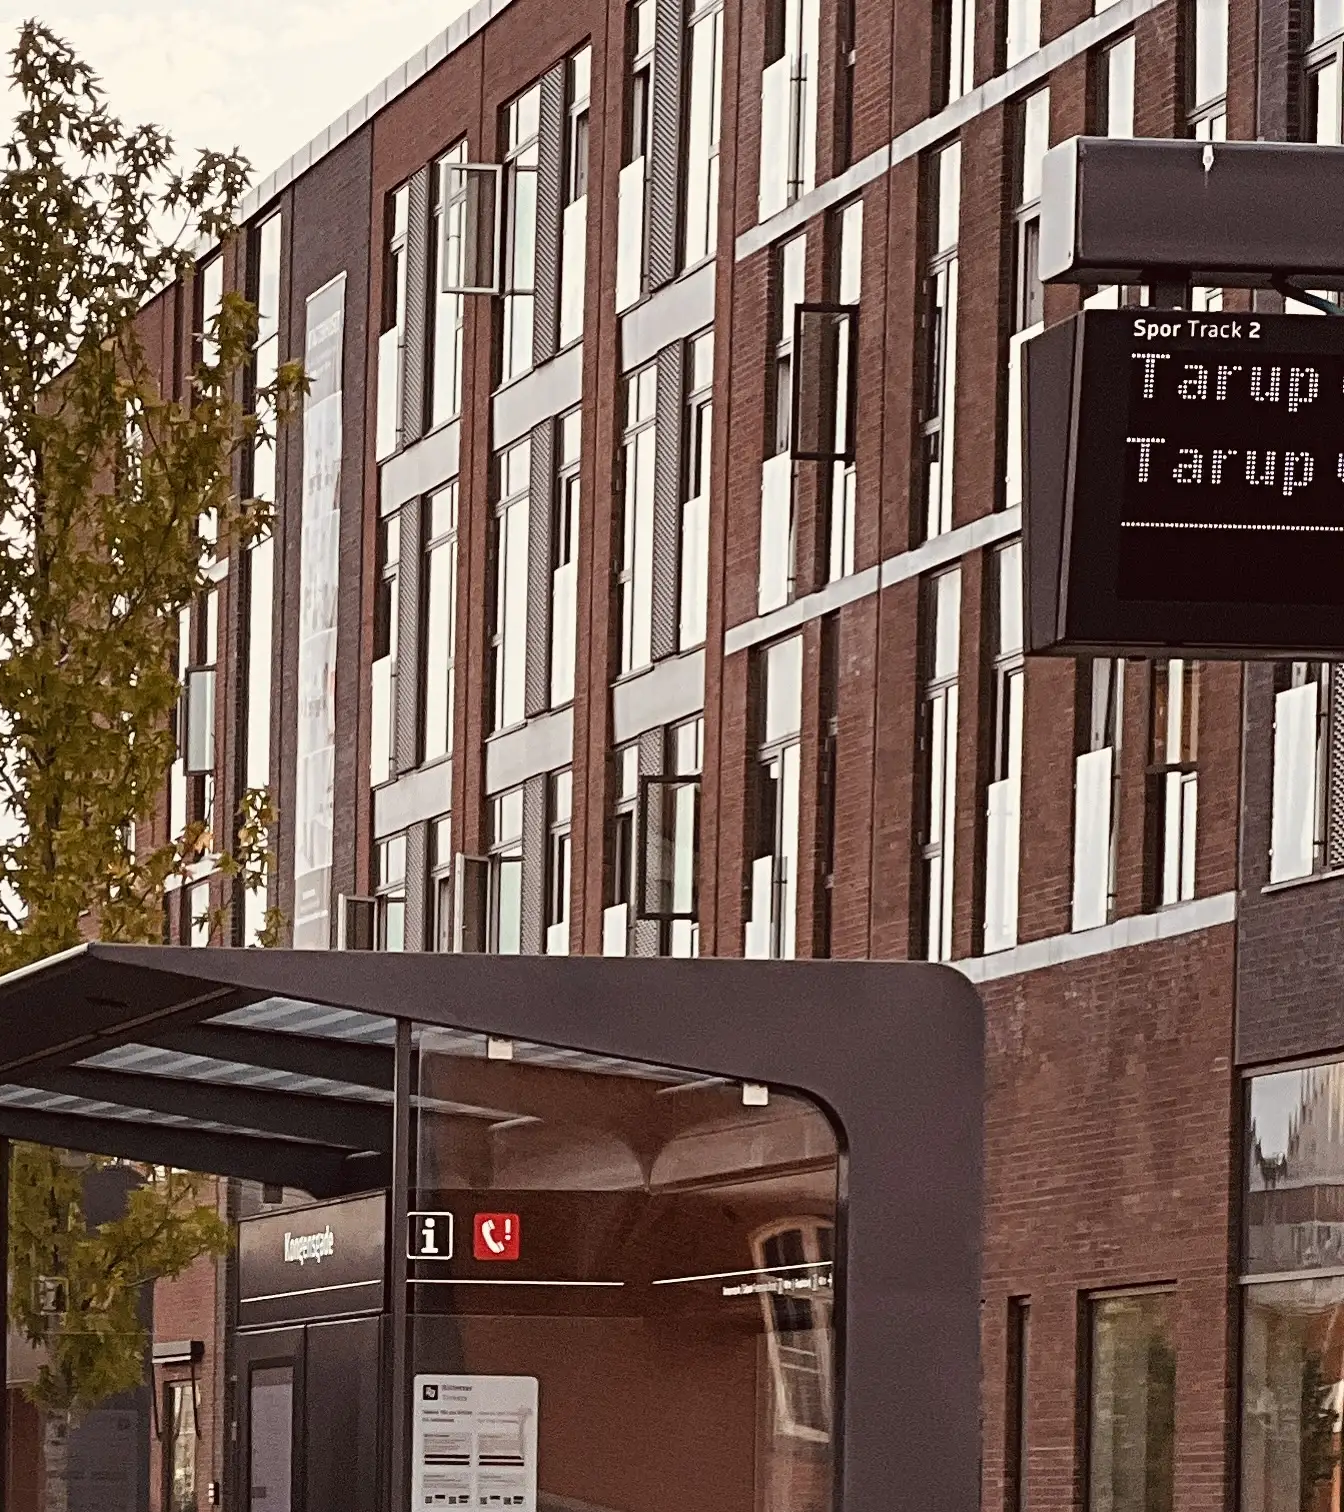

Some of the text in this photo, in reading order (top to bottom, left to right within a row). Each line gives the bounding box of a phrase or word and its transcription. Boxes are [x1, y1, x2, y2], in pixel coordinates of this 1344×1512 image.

[1133, 319, 1261, 340] Spor Track 2
[1131, 352, 1319, 412] Tarup
[1126, 437, 1315, 496] Tarup
